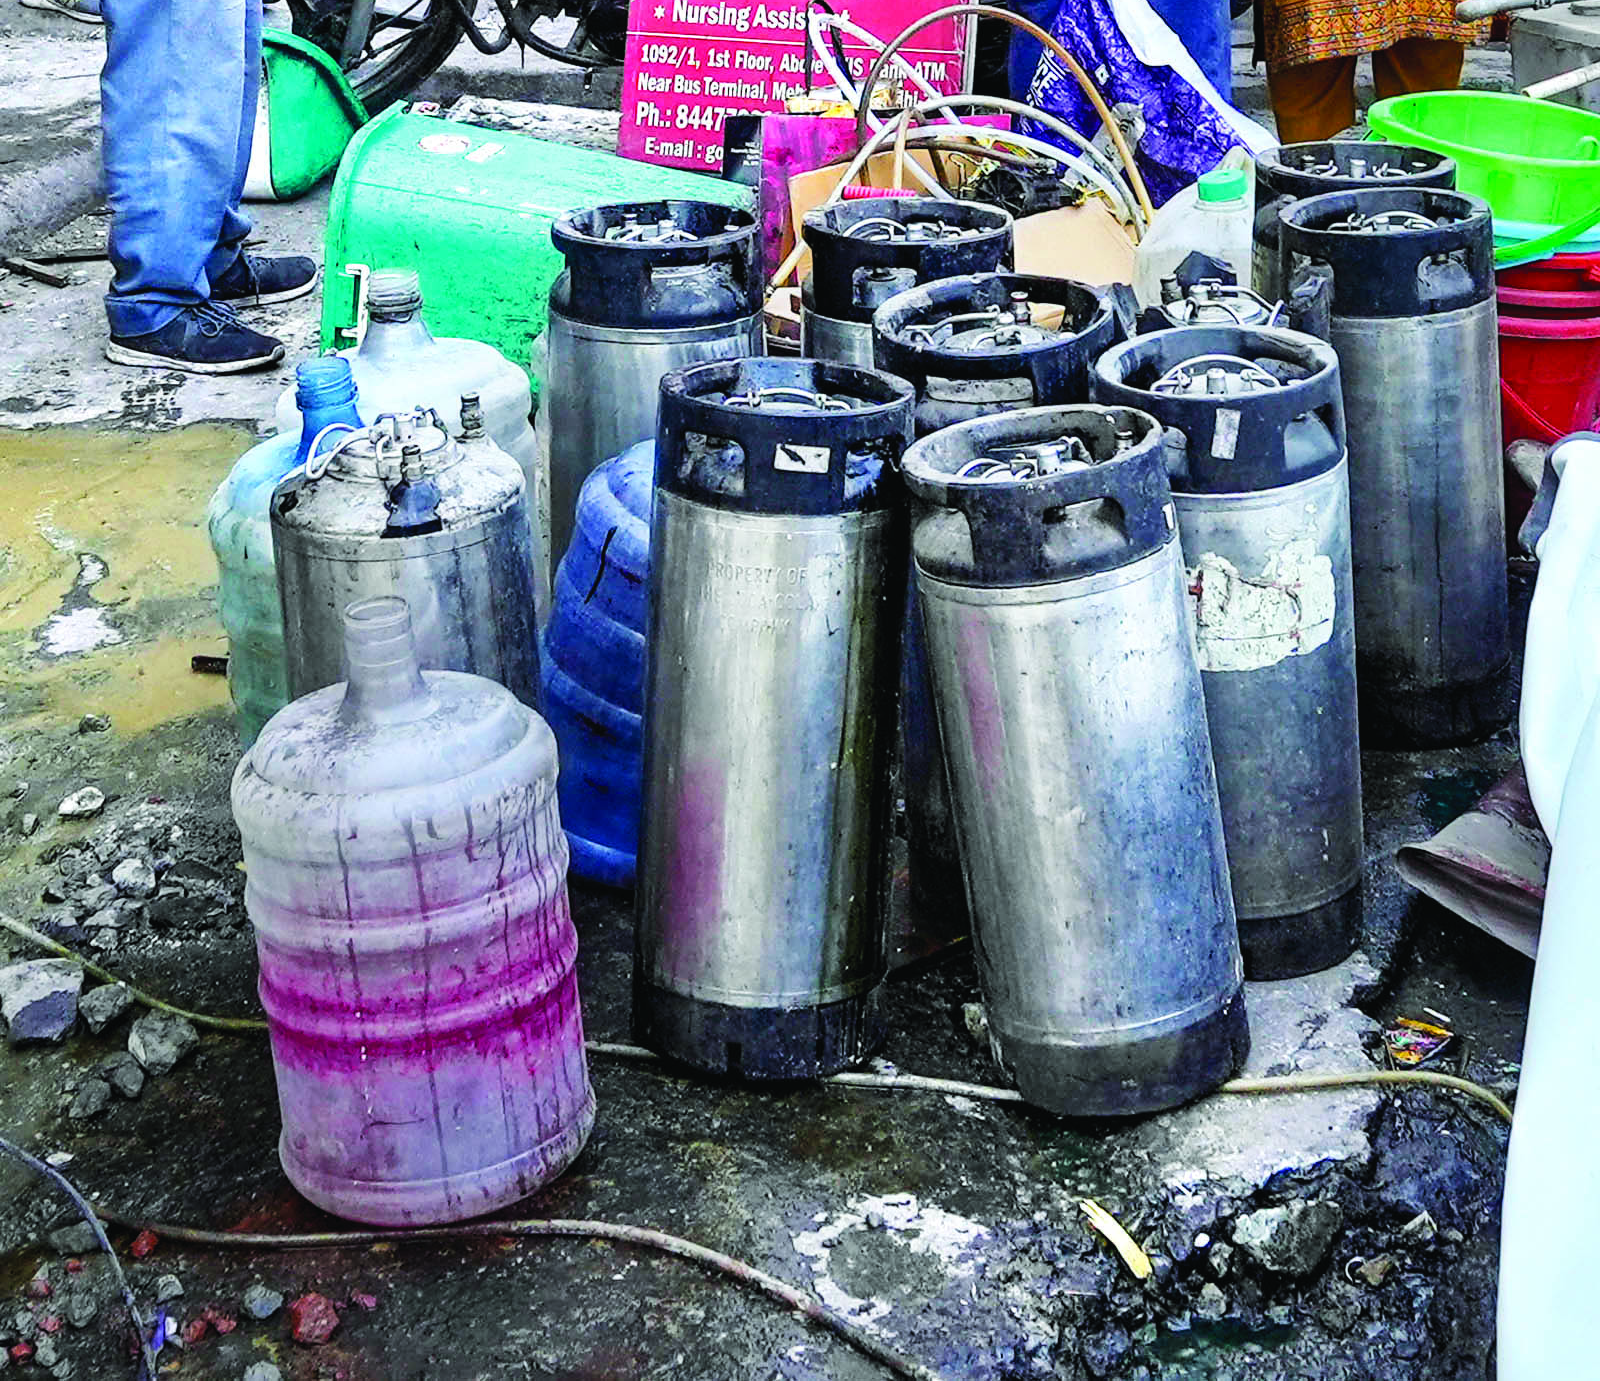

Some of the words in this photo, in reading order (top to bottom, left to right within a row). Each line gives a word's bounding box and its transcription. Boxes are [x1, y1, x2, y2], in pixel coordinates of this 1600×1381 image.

[640, 43, 701, 70] 1092/1,
[706, 47, 731, 68] 1st
[734, 49, 774, 74] Floor,
[637, 73, 672, 93] Near
[674, 74, 701, 95] Bus
[703, 78, 769, 102] Terminal,
[644, 137, 694, 158] E-mail
